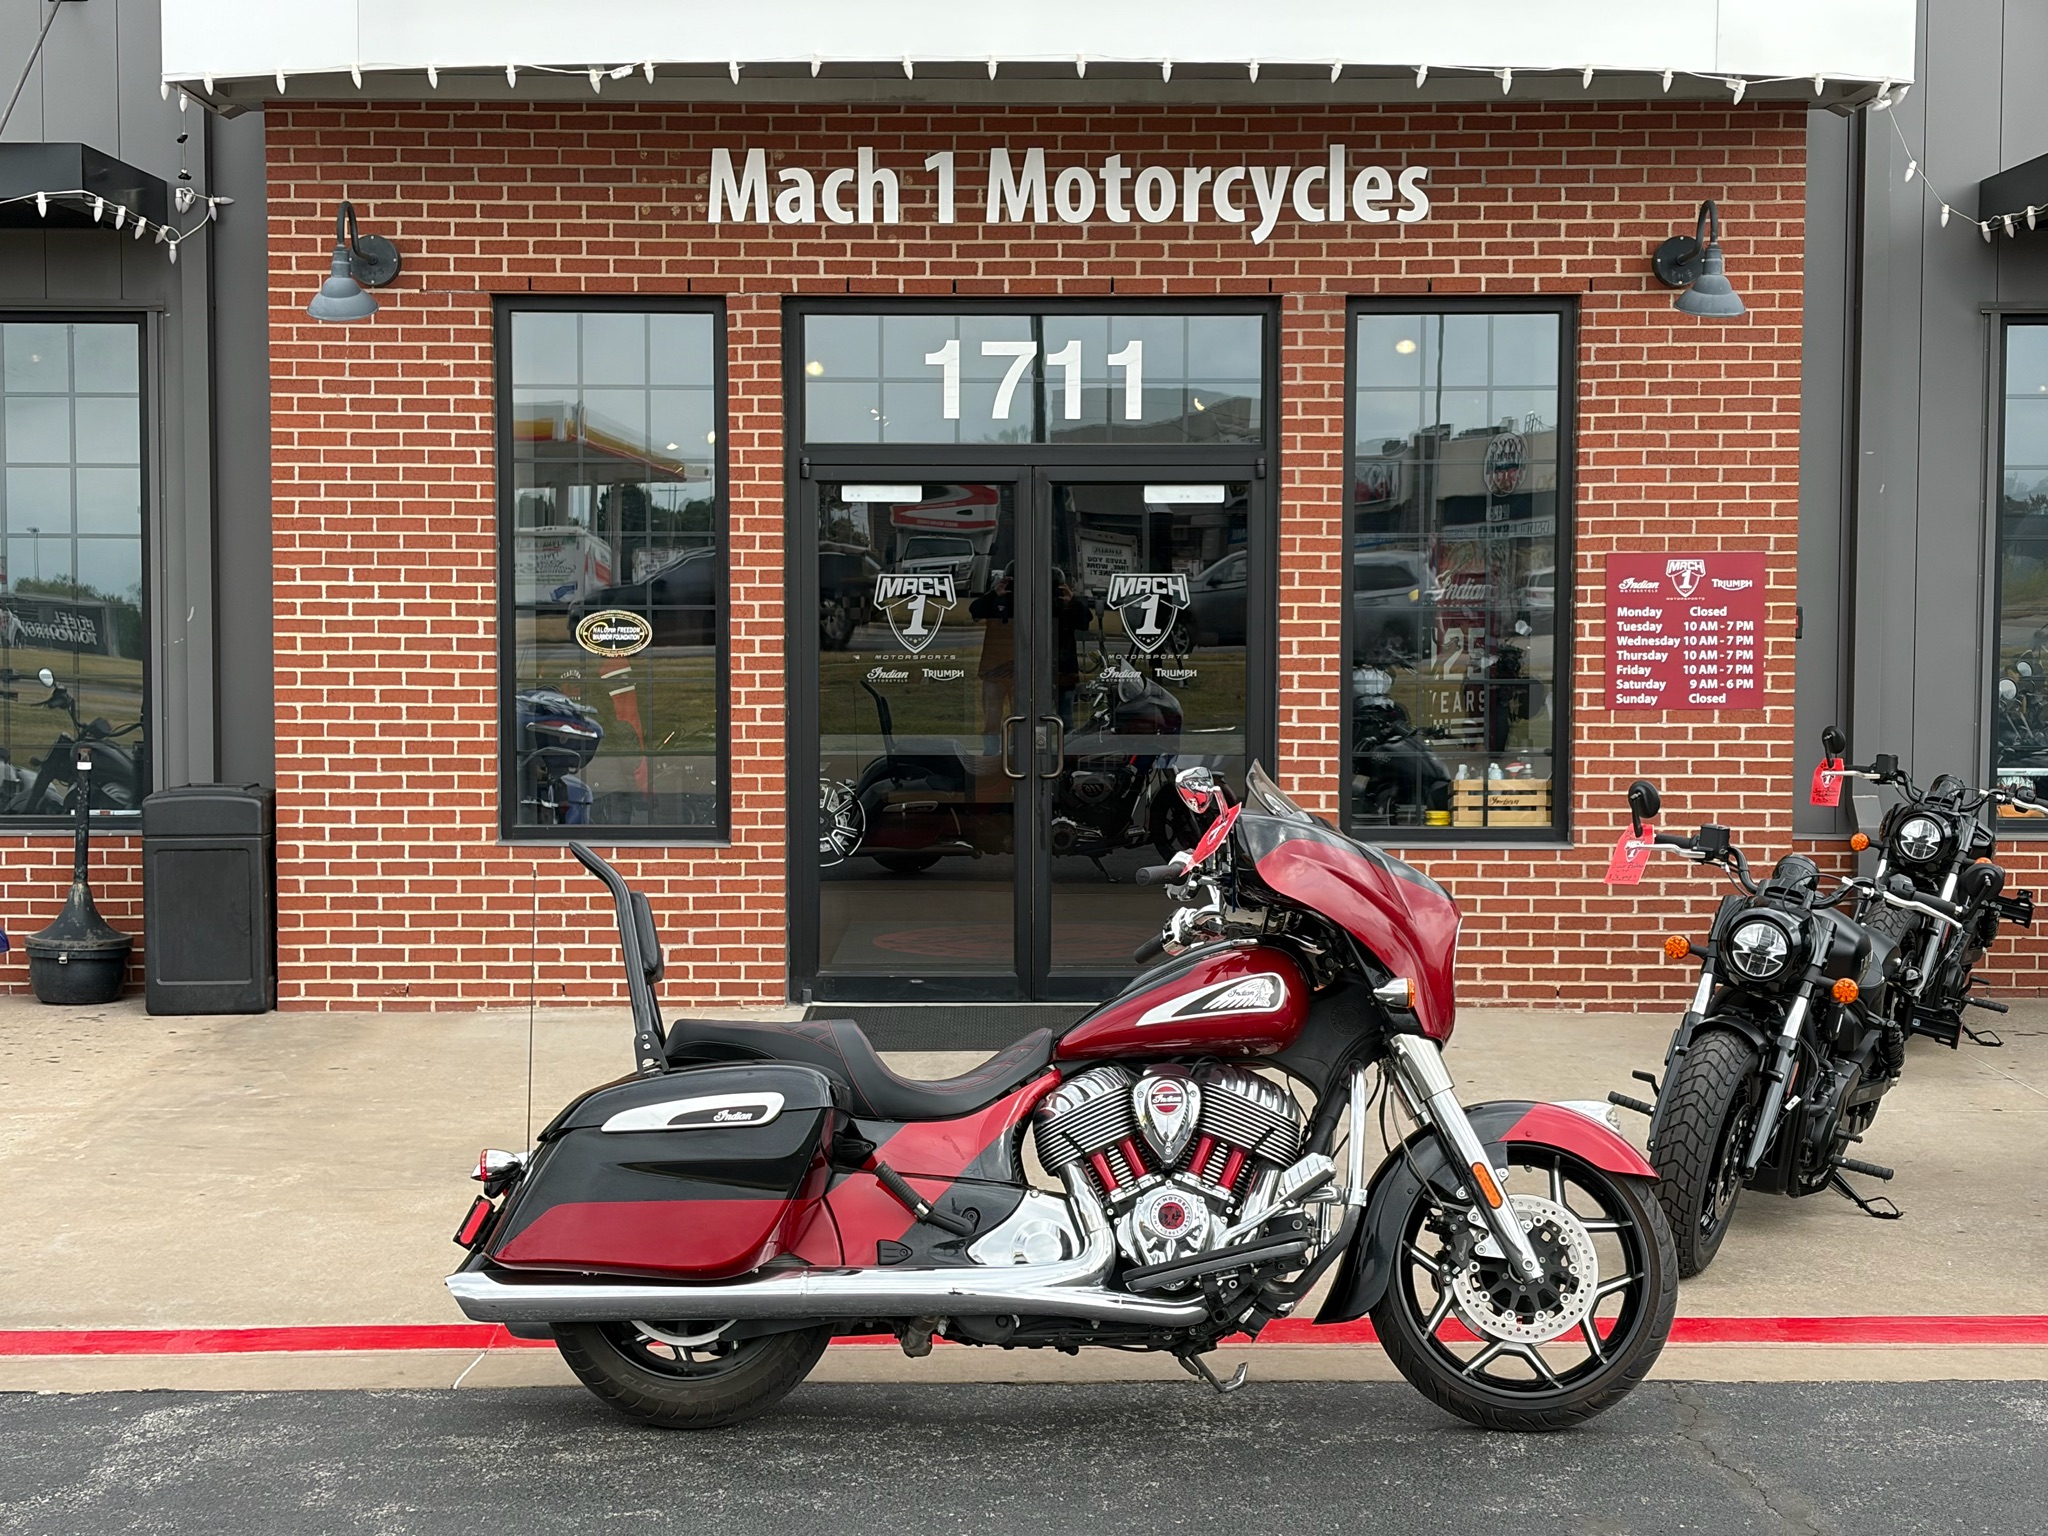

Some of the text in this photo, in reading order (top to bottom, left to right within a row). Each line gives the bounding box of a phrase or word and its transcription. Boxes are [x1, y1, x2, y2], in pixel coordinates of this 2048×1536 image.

[708, 144, 1430, 245] Mach 1 Motorcycles
[925, 339, 1144, 420] 1711
[1618, 577, 1660, 589] Indian
[1679, 569, 1692, 589] 1
[1711, 578, 1753, 591] TRIUMPH
[878, 577, 953, 603] MACH
[1111, 577, 1186, 602] MACH
[902, 594, 928, 636] 1
[1135, 594, 1162, 635] 1
[1617, 606, 1727, 620] Monday Closed
[1616, 621, 1663, 634] Tuesday
[1684, 621, 1698, 631] 10
[1699, 621, 1718, 631] AM
[1726, 621, 1734, 631] 7
[1736, 621, 1754, 631] PM
[1616, 636, 1680, 648] Wednesday
[1684, 636, 1698, 645] 10
[1699, 636, 1718, 645] AM
[1726, 636, 1734, 645] 7
[1736, 636, 1754, 645] PM
[1616, 650, 1668, 662] Thursday
[1683, 650, 1698, 660] 10
[1699, 650, 1718, 660] AM
[1726, 650, 1734, 660] 7
[1736, 650, 1754, 660] PM
[866, 666, 909, 679] Indian
[922, 668, 964, 681] TRIUMPH
[1099, 666, 1142, 679] Indian
[1155, 668, 1197, 681] TRIUMPH
[1616, 664, 1651, 677] Friday
[1683, 664, 1697, 674] 10
[1699, 664, 1718, 674] AM
[1726, 664, 1734, 674] 7
[1736, 664, 1754, 674] PM
[1616, 679, 1666, 691] Saturday
[1690, 679, 1697, 689] 9
[1699, 679, 1718, 689] AM
[1726, 679, 1734, 689] 6
[1736, 679, 1754, 689] PM
[1616, 693, 1727, 706] Sunday Closed
[1227, 989, 1255, 997] Indian
[713, 1110, 753, 1122] Indian
